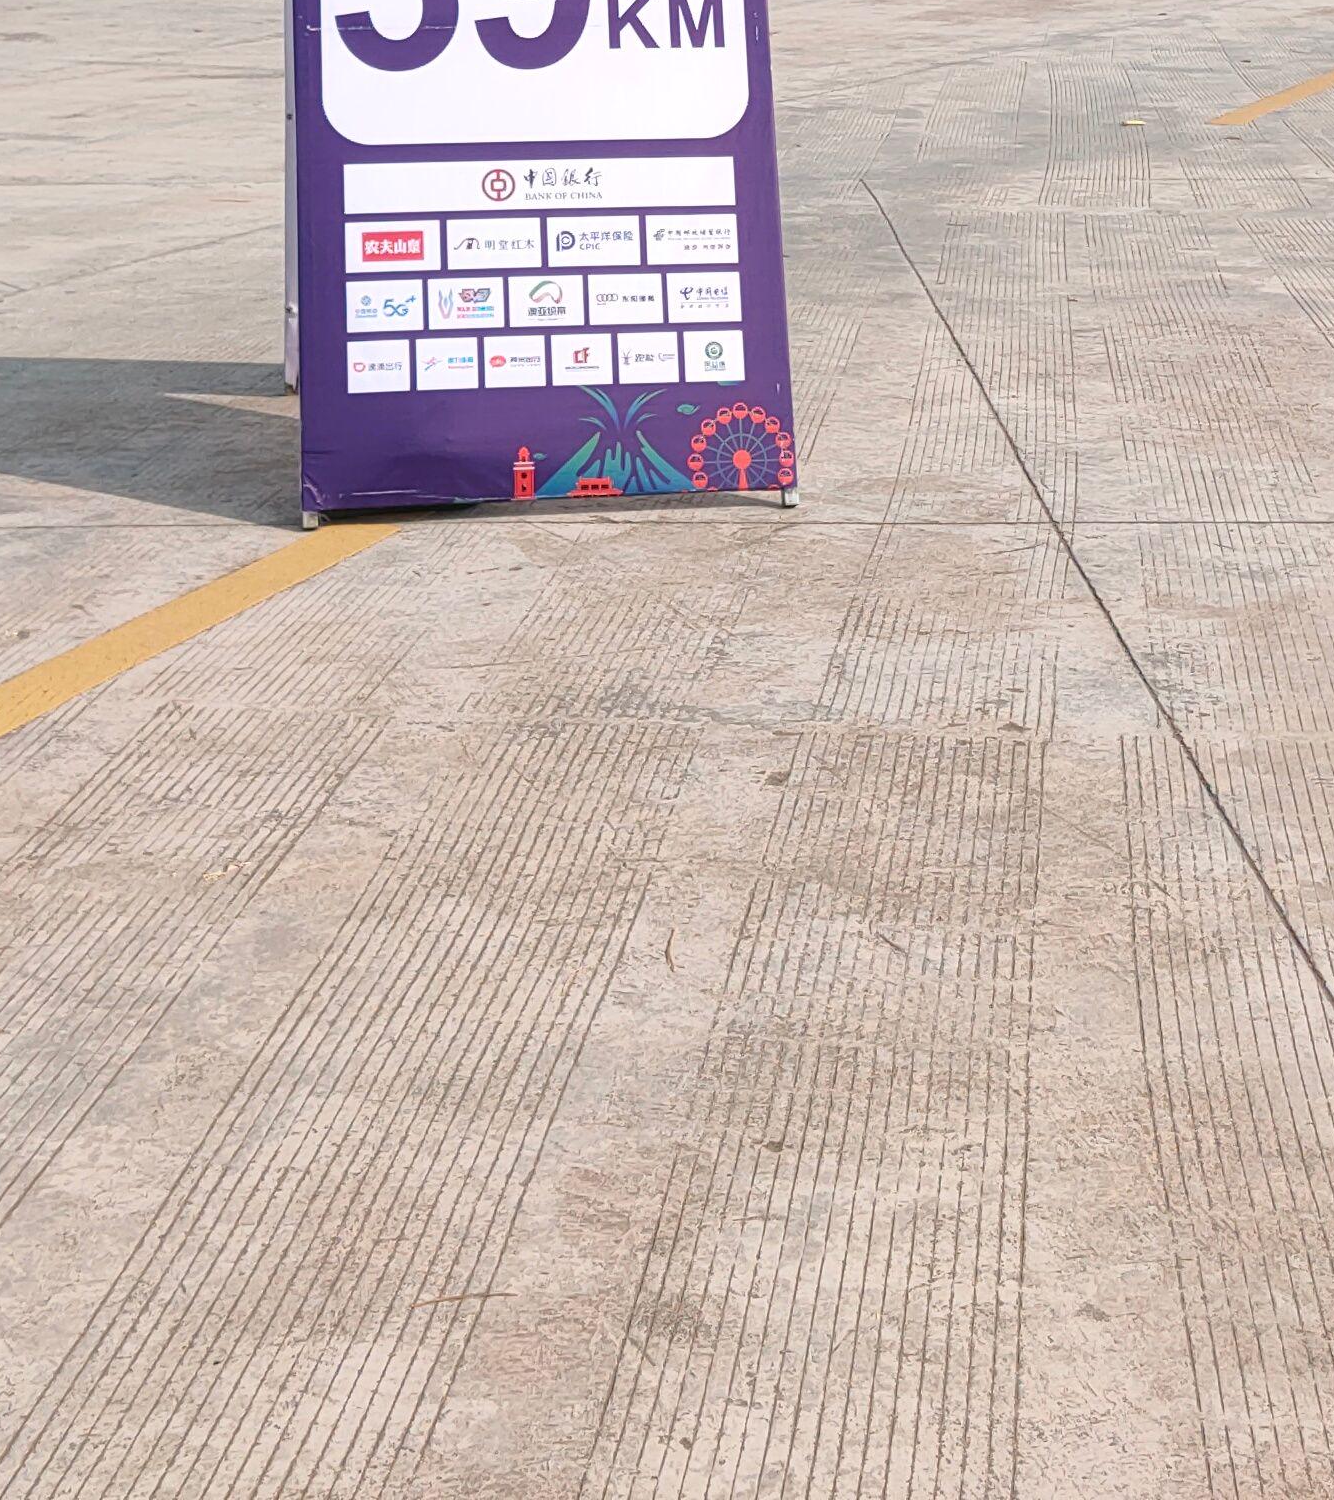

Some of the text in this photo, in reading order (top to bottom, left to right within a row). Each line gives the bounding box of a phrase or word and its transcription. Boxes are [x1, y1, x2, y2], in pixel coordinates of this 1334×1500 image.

[525, 190, 603, 201] BANK OF CHINA
[579, 230, 634, 242] 太平洋保险
[364, 238, 421, 255] 农夫山泉
